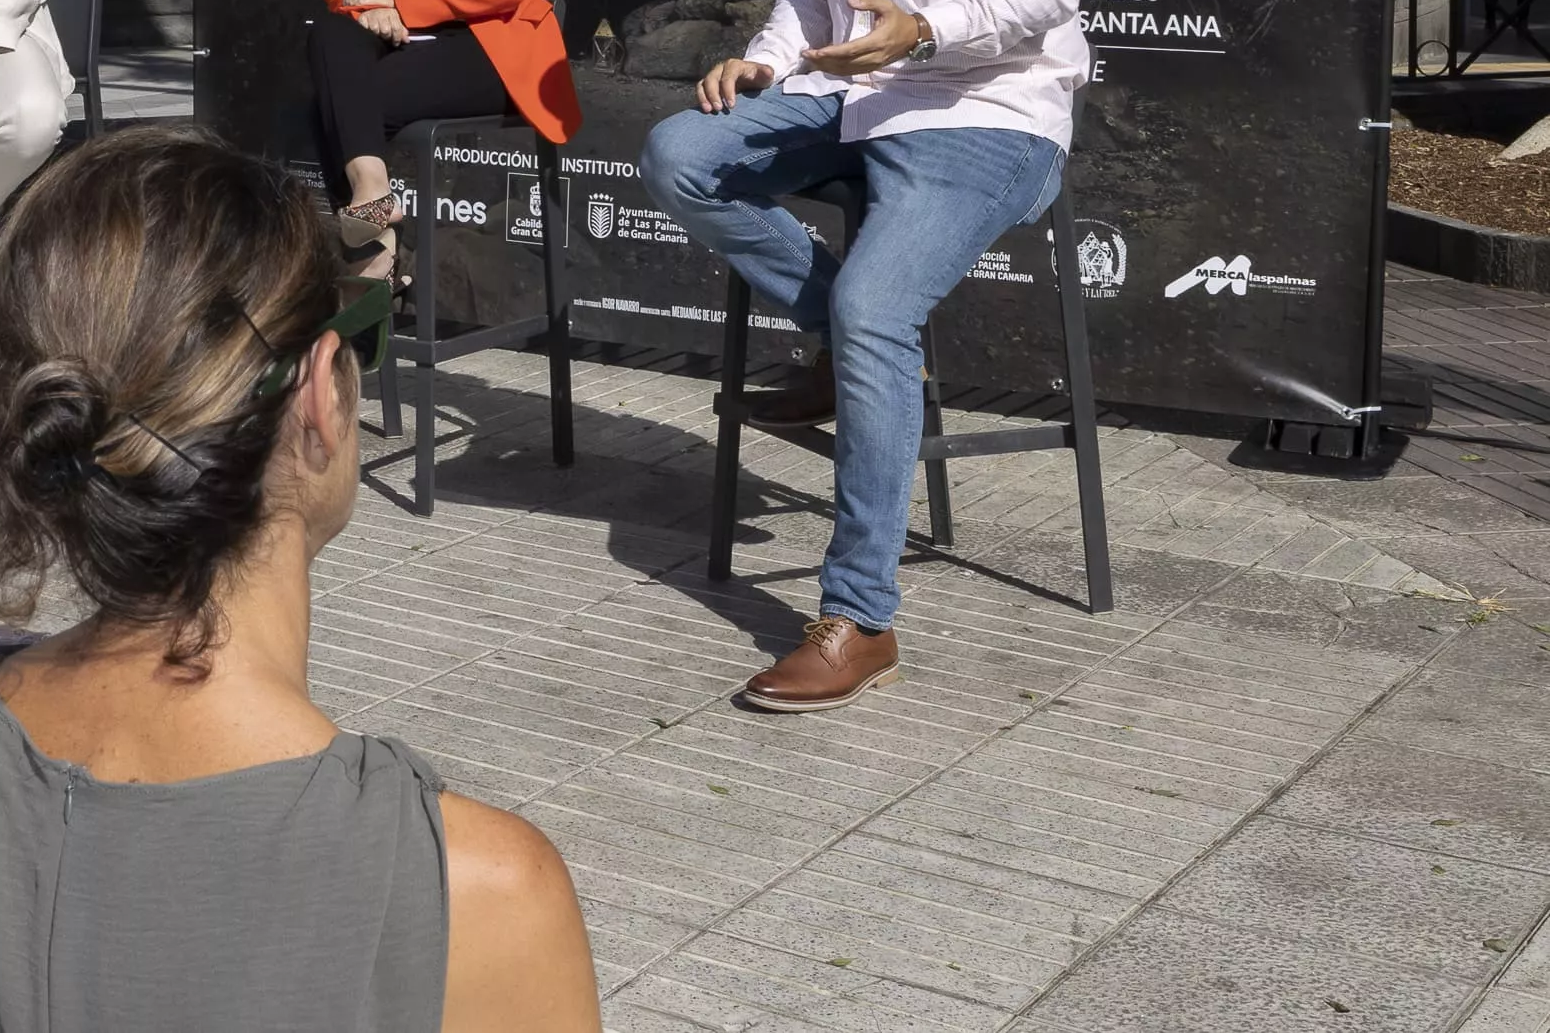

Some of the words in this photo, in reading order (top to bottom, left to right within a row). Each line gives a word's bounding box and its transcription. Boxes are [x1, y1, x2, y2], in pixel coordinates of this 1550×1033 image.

[1078, 11, 1159, 36] SANTA
[1162, 14, 1222, 38] ANA
[1091, 60, 1107, 82] E
[434, 146, 443, 160] A
[444, 147, 532, 169] PRODUCCIÓN
[561, 157, 634, 178] INSTITUTO
[389, 178, 405, 190] os
[618, 205, 672, 221] Ayuntami
[515, 217, 543, 229] Cabild
[617, 216, 631, 227] de
[634, 219, 651, 229] Las
[654, 220, 688, 233] Palma
[510, 226, 531, 237] Gran
[617, 227, 630, 238] de
[630, 229, 653, 241] Gran
[654, 231, 689, 244] Canaria
[978, 260, 1011, 272] PALMAS
[973, 269, 996, 280] GRAN
[997, 271, 1034, 284] CANARIA
[702, 308, 710, 322] DE
[710, 309, 722, 323] LAS
[754, 315, 771, 329] GRAN
